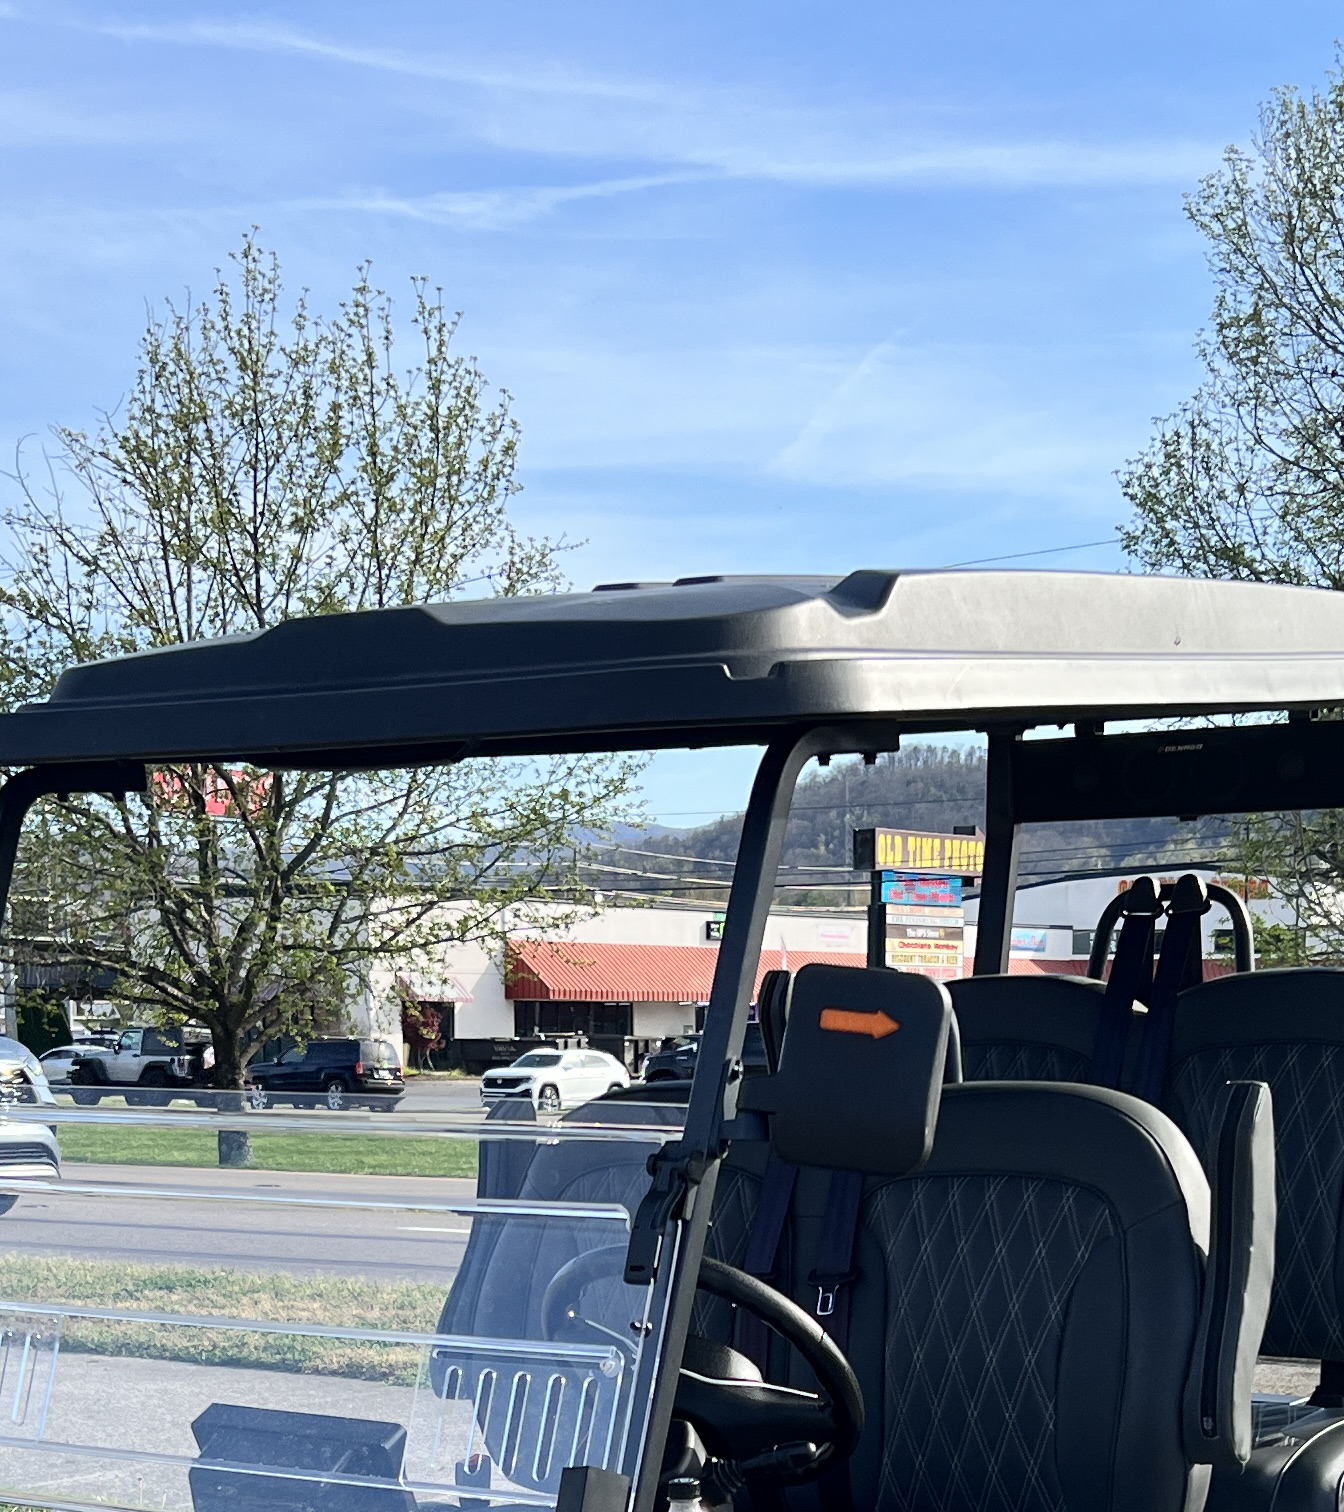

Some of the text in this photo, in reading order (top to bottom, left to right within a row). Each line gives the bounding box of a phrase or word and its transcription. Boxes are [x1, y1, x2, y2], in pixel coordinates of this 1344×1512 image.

[878, 834, 903, 867] OLD
[907, 836, 941, 868] TIME
[898, 941, 959, 952] Chocolate Monkey
